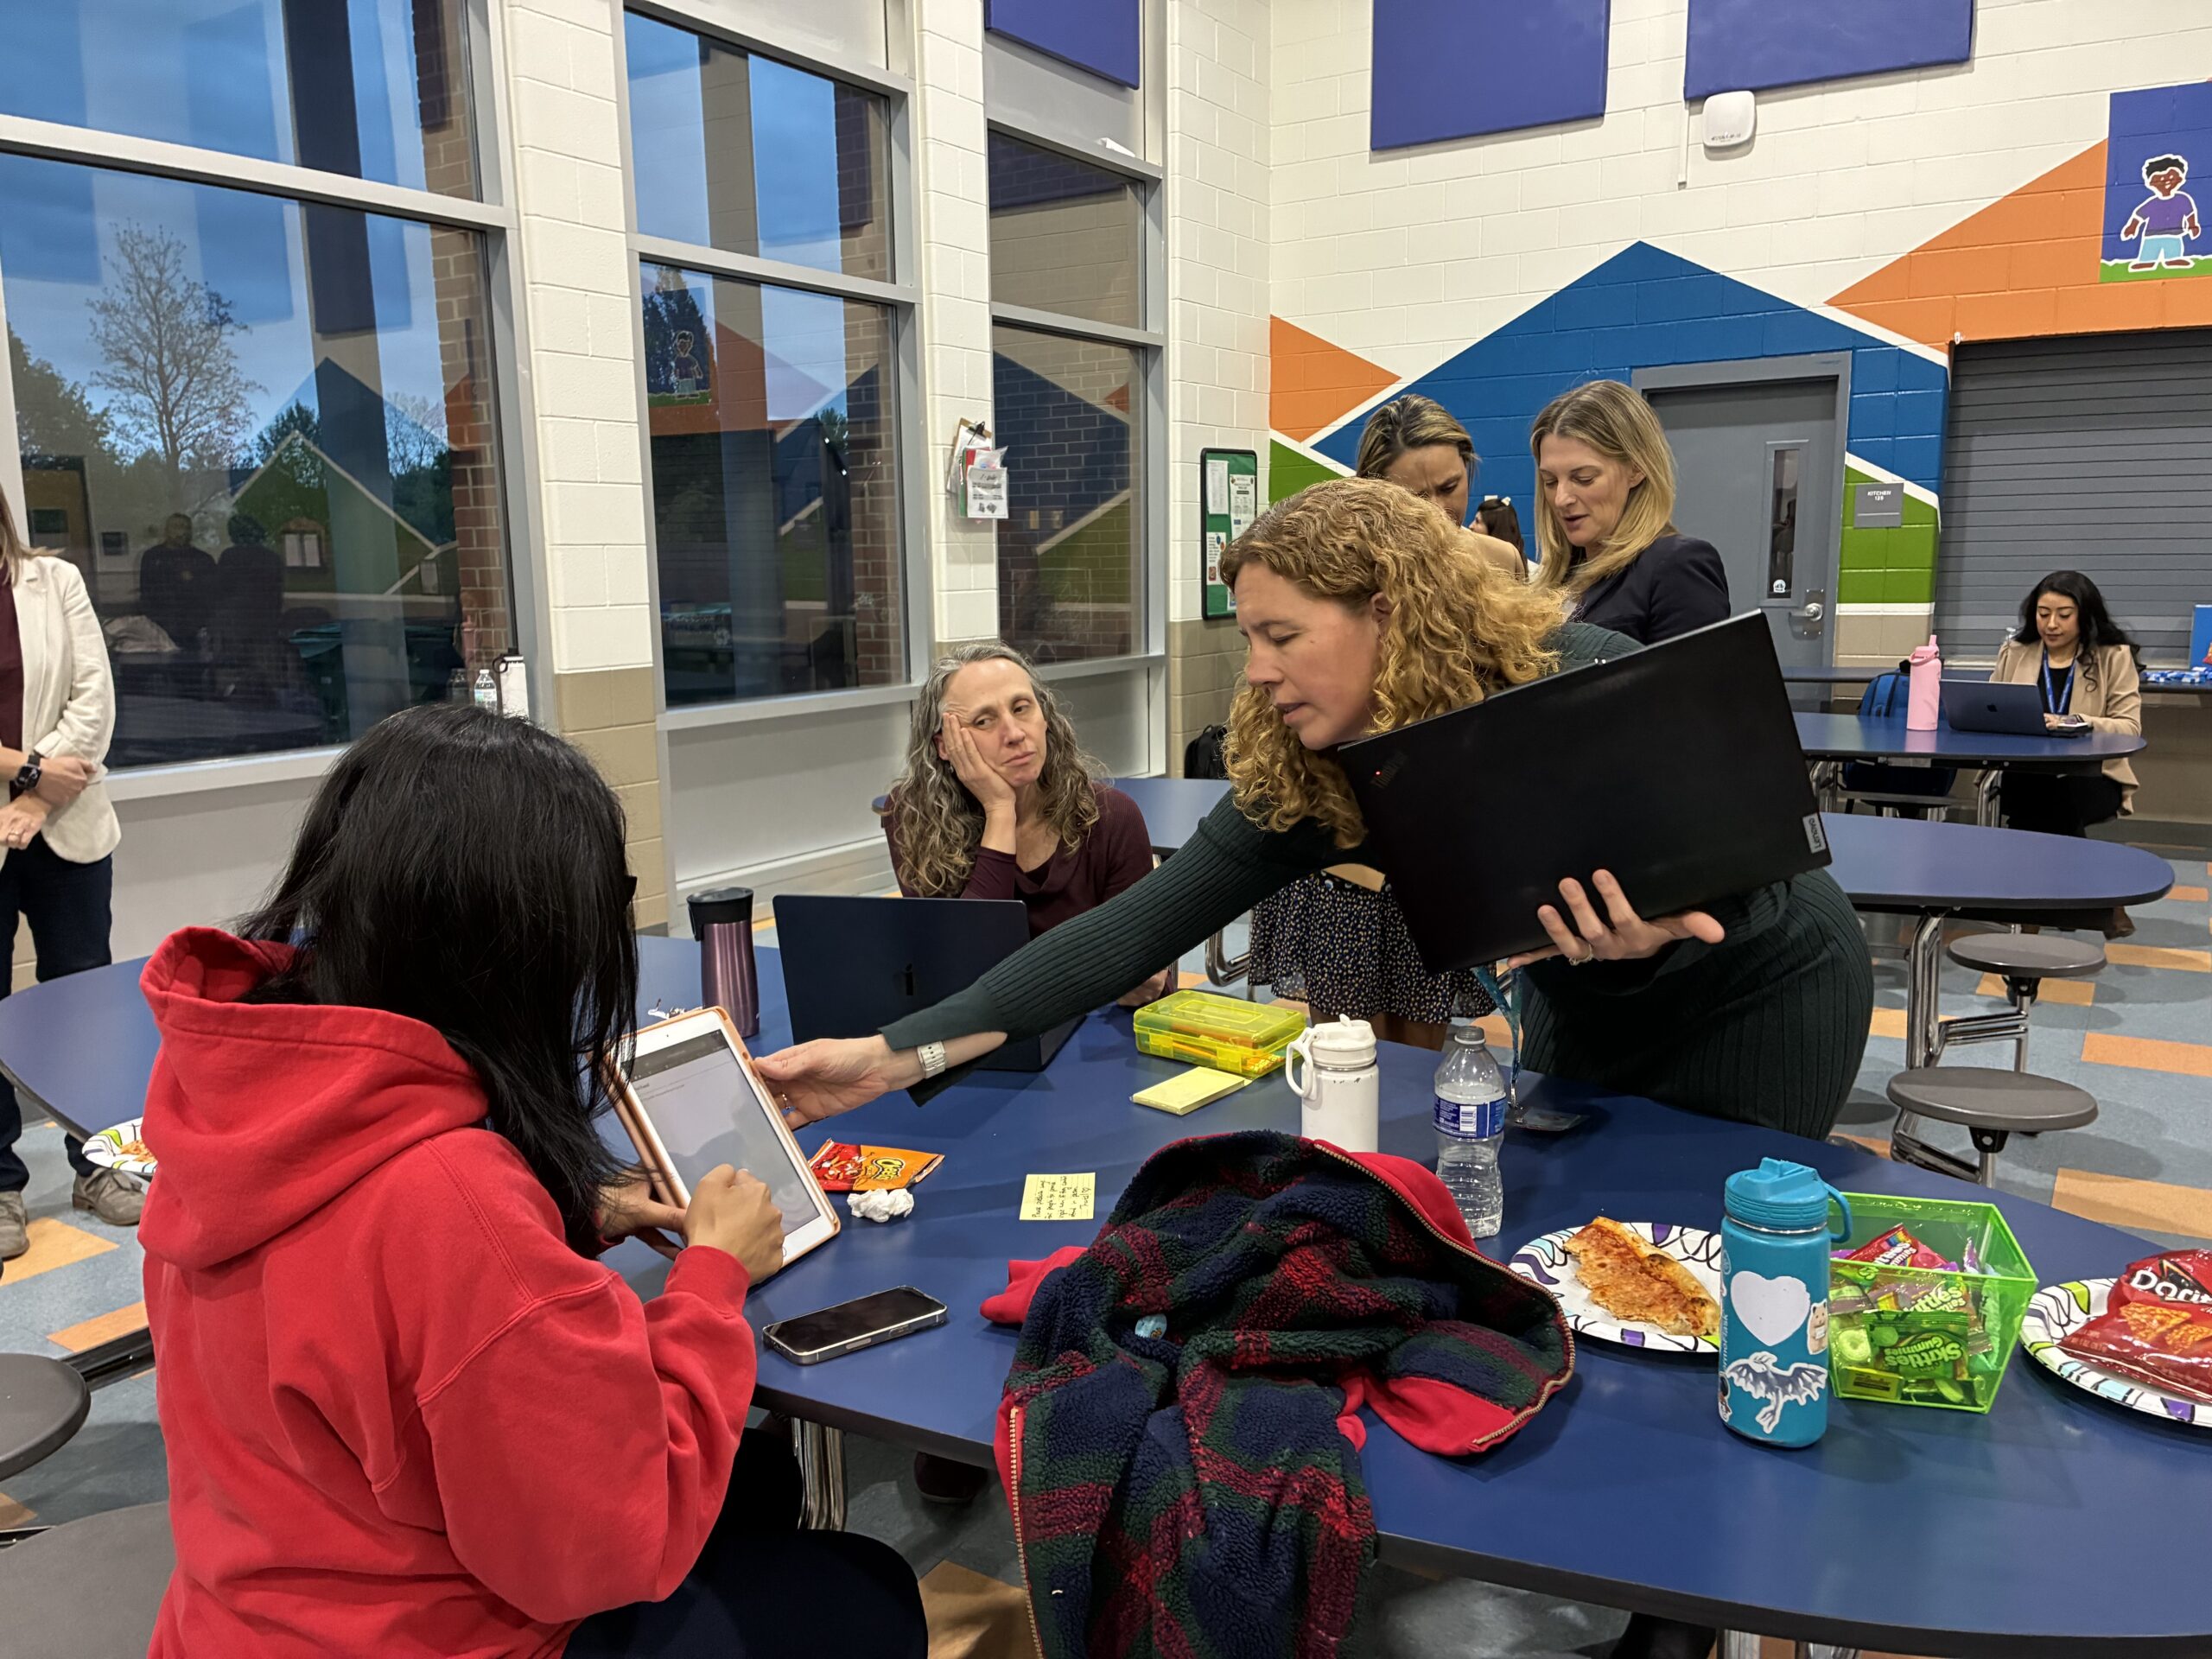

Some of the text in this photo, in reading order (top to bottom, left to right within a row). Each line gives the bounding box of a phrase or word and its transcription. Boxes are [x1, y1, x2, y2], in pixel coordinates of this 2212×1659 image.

[2130, 1269, 2212, 1304] Dorit
[1884, 1336, 1943, 1356] Gummies
[1885, 1342, 1962, 1369] Skittles
